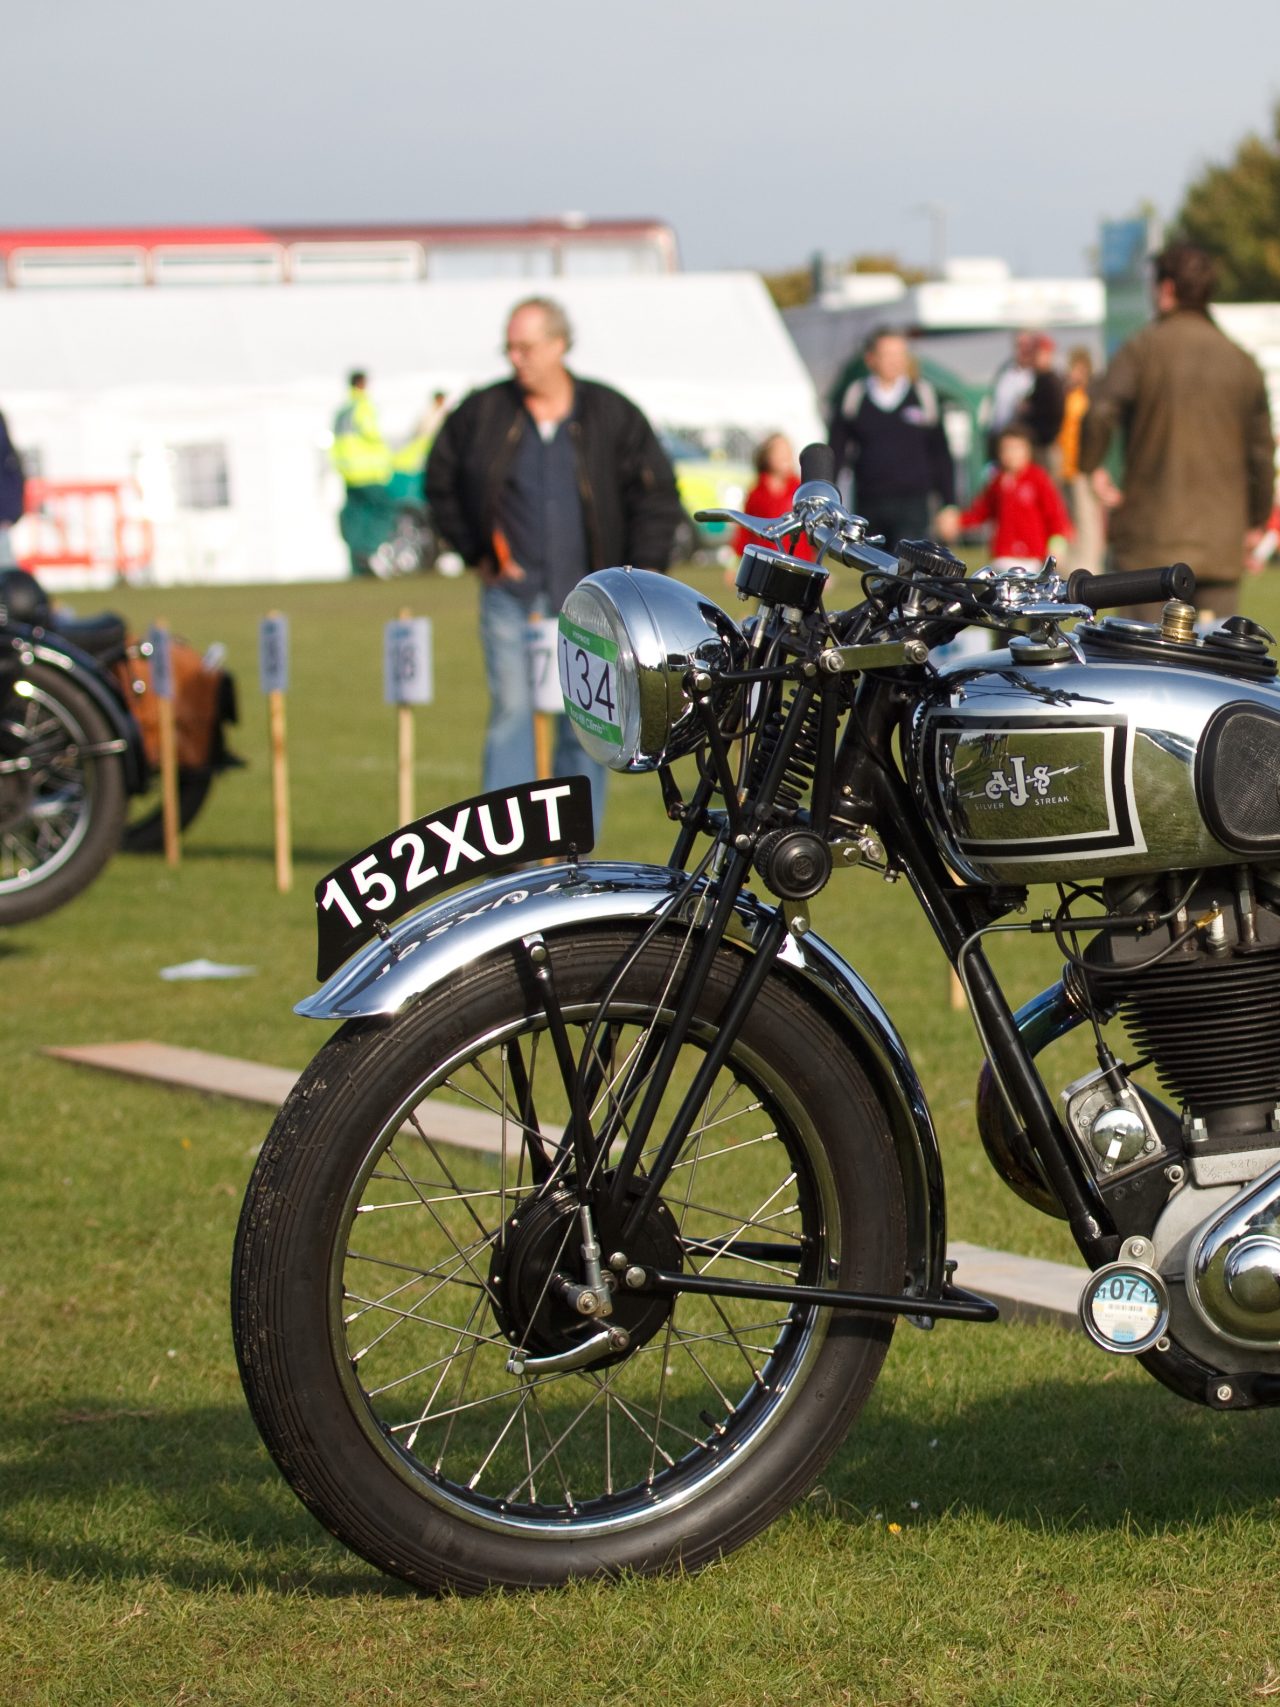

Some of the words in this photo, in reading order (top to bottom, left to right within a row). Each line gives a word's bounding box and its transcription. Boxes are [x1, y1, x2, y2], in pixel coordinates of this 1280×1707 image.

[563, 638, 615, 721] 134
[974, 802, 1005, 811] SILVER
[1034, 795, 1070, 806] STREAK
[321, 785, 571, 928] 152XUT
[1110, 1278, 1139, 1301] 07
